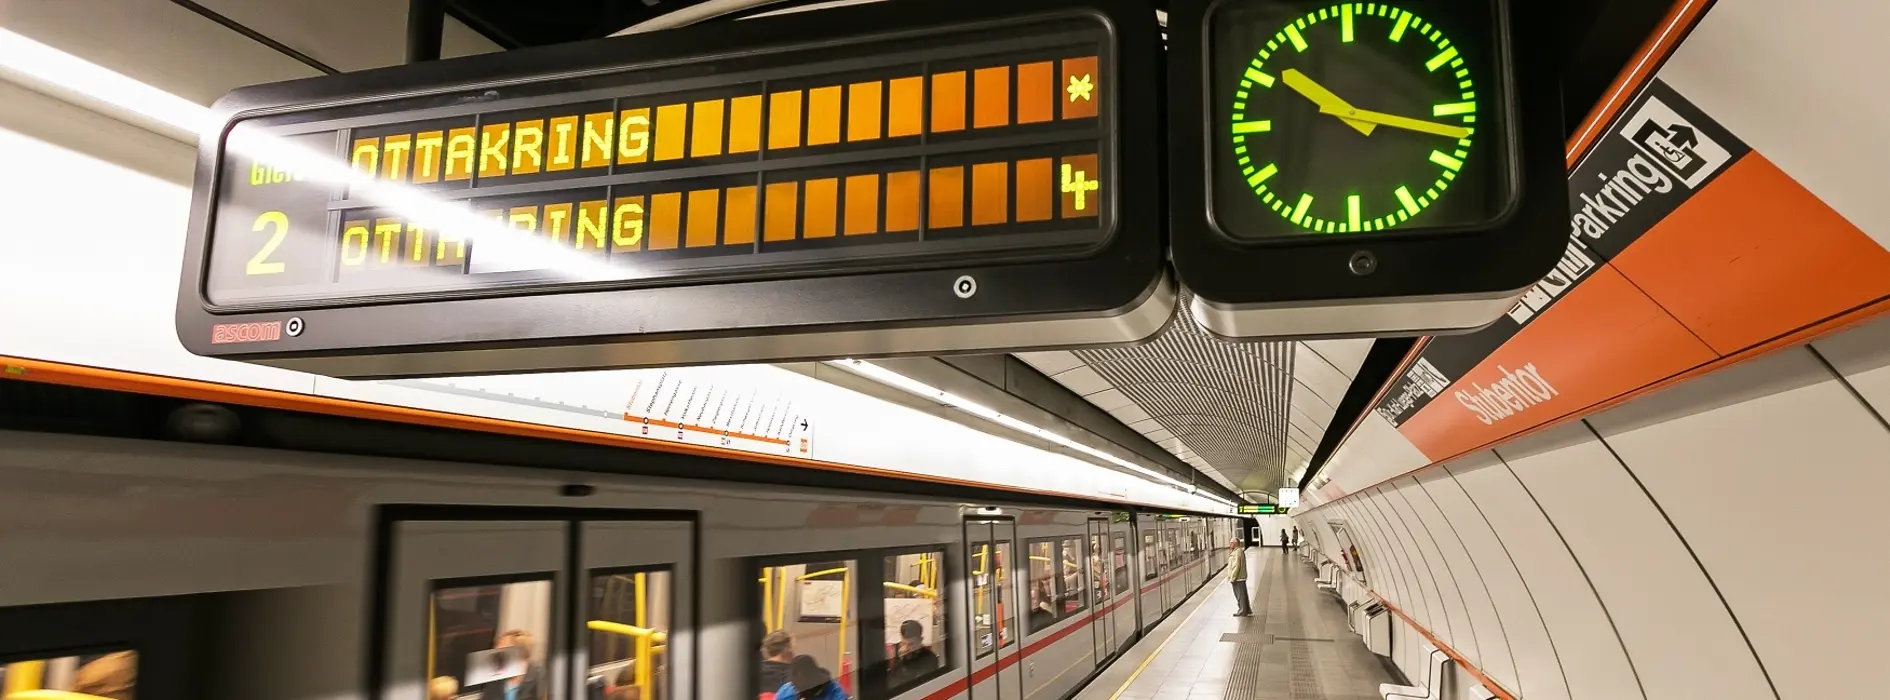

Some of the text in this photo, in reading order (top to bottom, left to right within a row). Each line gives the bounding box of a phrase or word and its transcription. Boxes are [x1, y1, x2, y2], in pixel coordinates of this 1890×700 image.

[352, 115, 650, 179] OTTAKRING
[246, 210, 289, 276] 2
[213, 322, 282, 342] ascom
[1454, 362, 1560, 425] Stubentor
